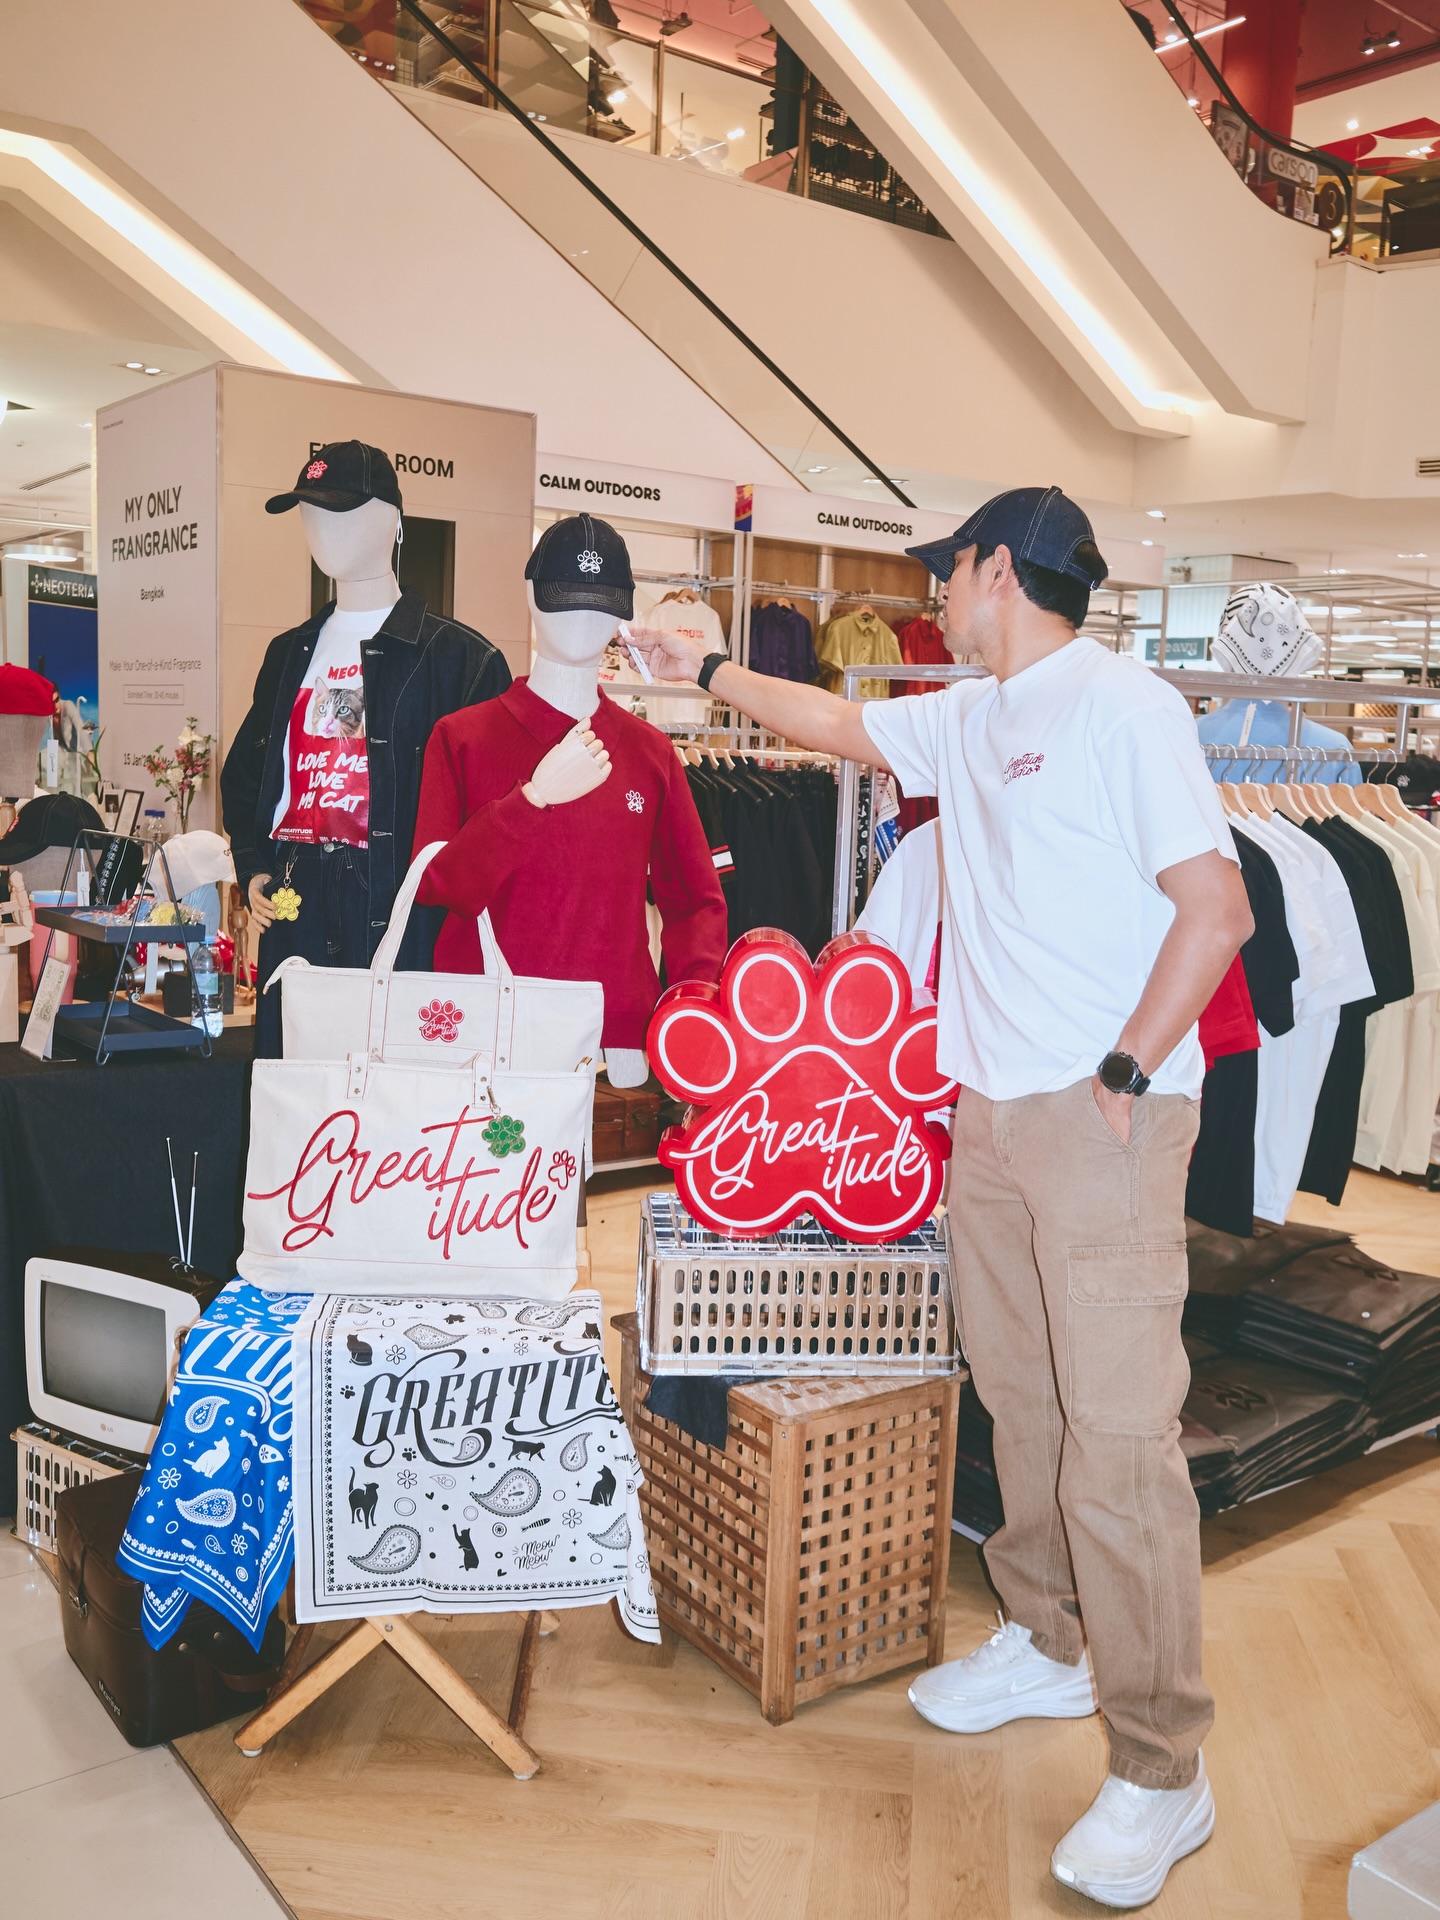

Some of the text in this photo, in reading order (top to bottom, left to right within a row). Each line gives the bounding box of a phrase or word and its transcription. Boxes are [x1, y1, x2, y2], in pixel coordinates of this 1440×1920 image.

[1270, 151, 1317, 186] carson
[1326, 189, 1338, 221] 3
[395, 453, 454, 479] ROOM
[539, 473, 661, 501] CALM OUTDOORS
[124, 485, 182, 524] MY ONLY
[817, 511, 913, 537] CALM OUTDOORS
[112, 522, 198, 563] FRANGRANCE
[140, 586, 165, 602] Bangkok
[109, 660, 122, 672] Make
[123, 660, 135, 672] Your
[173, 658, 202, 673] Fragrance
[123, 753, 131, 765] 15
[297, 750, 368, 774] LOVE ME
[308, 770, 348, 790] LOVE
[297, 791, 365, 814] MY CAT
[669, 1081, 875, 1200] Great
[820, 1115, 929, 1205] itude
[247, 1104, 494, 1252] Great
[425, 1146, 557, 1260] itude
[521, 1534, 560, 1556] Meow
[514, 1549, 553, 1570] Meow
